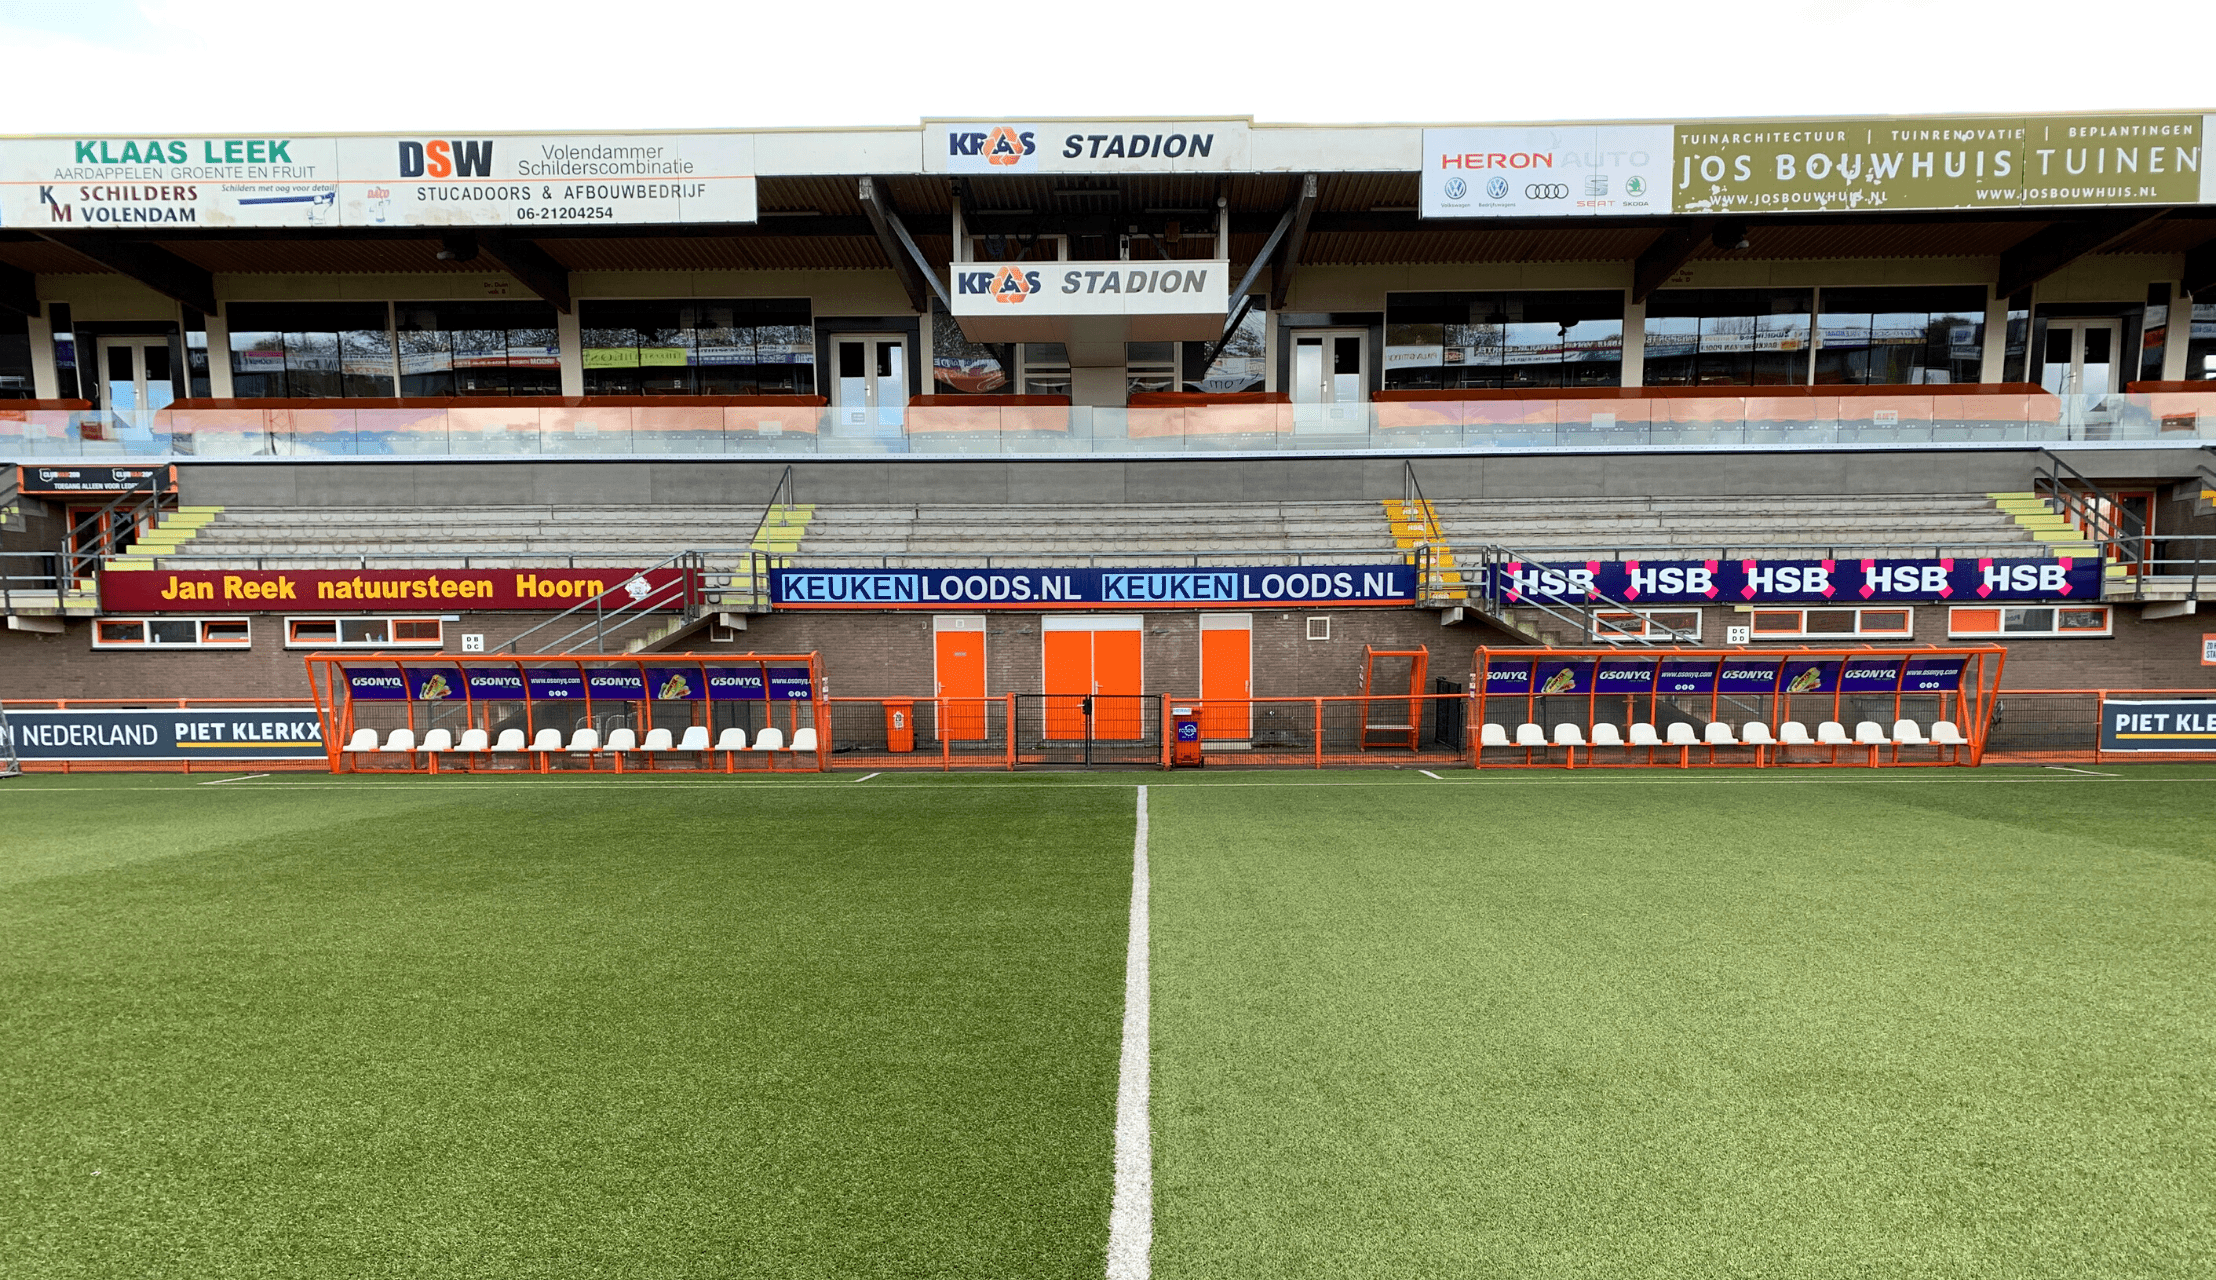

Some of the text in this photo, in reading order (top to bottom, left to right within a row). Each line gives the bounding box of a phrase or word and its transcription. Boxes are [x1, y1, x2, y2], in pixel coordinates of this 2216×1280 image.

[1681, 130, 1846, 145] TUINARCHITECTUUR
[1892, 128, 2023, 141] TUINRENOVATIE
[2068, 125, 2193, 138] BEPLANTINGEN
[75, 140, 292, 164] KLAAS LEEK
[541, 144, 664, 160] Volendammer
[949, 131, 1214, 158] KRAS STADION
[398, 139, 493, 178] DSW
[518, 158, 694, 177] Schilderscombinatie
[1441, 150, 1650, 170] HERON AUTO
[1679, 146, 2198, 189] JOS BOUWHUIS TUINEN
[54, 165, 315, 180] AARDAPPELEN GROENTE EN FRUIT
[80, 185, 198, 202] SCHILDERS
[221, 184, 256, 192] Schilders
[275, 185, 290, 194] oog
[417, 184, 706, 201] STUCADOORS & AFBOUWBEDRIJF
[1976, 186, 2158, 201] WWW.JOSBOUWHUIS.NL
[517, 206, 613, 221] 06-21204254
[1576, 200, 1616, 208] SEAT
[80, 206, 197, 223] VOLENDAM
[958, 269, 1207, 295] KRAS STADION
[161, 573, 604, 600] Jan Reek natuursteen Hoorn
[1513, 568, 1595, 595] HSB
[1631, 567, 1713, 594] HSB
[1748, 566, 1830, 593] HSB
[1866, 565, 1949, 592] HSB
[1983, 564, 2067, 592] HSB
[1487, 671, 1528, 680] SONYQ
[2115, 713, 2170, 732] PIET
[23, 724, 158, 746] NEDERLAND
[175, 722, 226, 741] PIET
[233, 721, 322, 740] KLERKX
